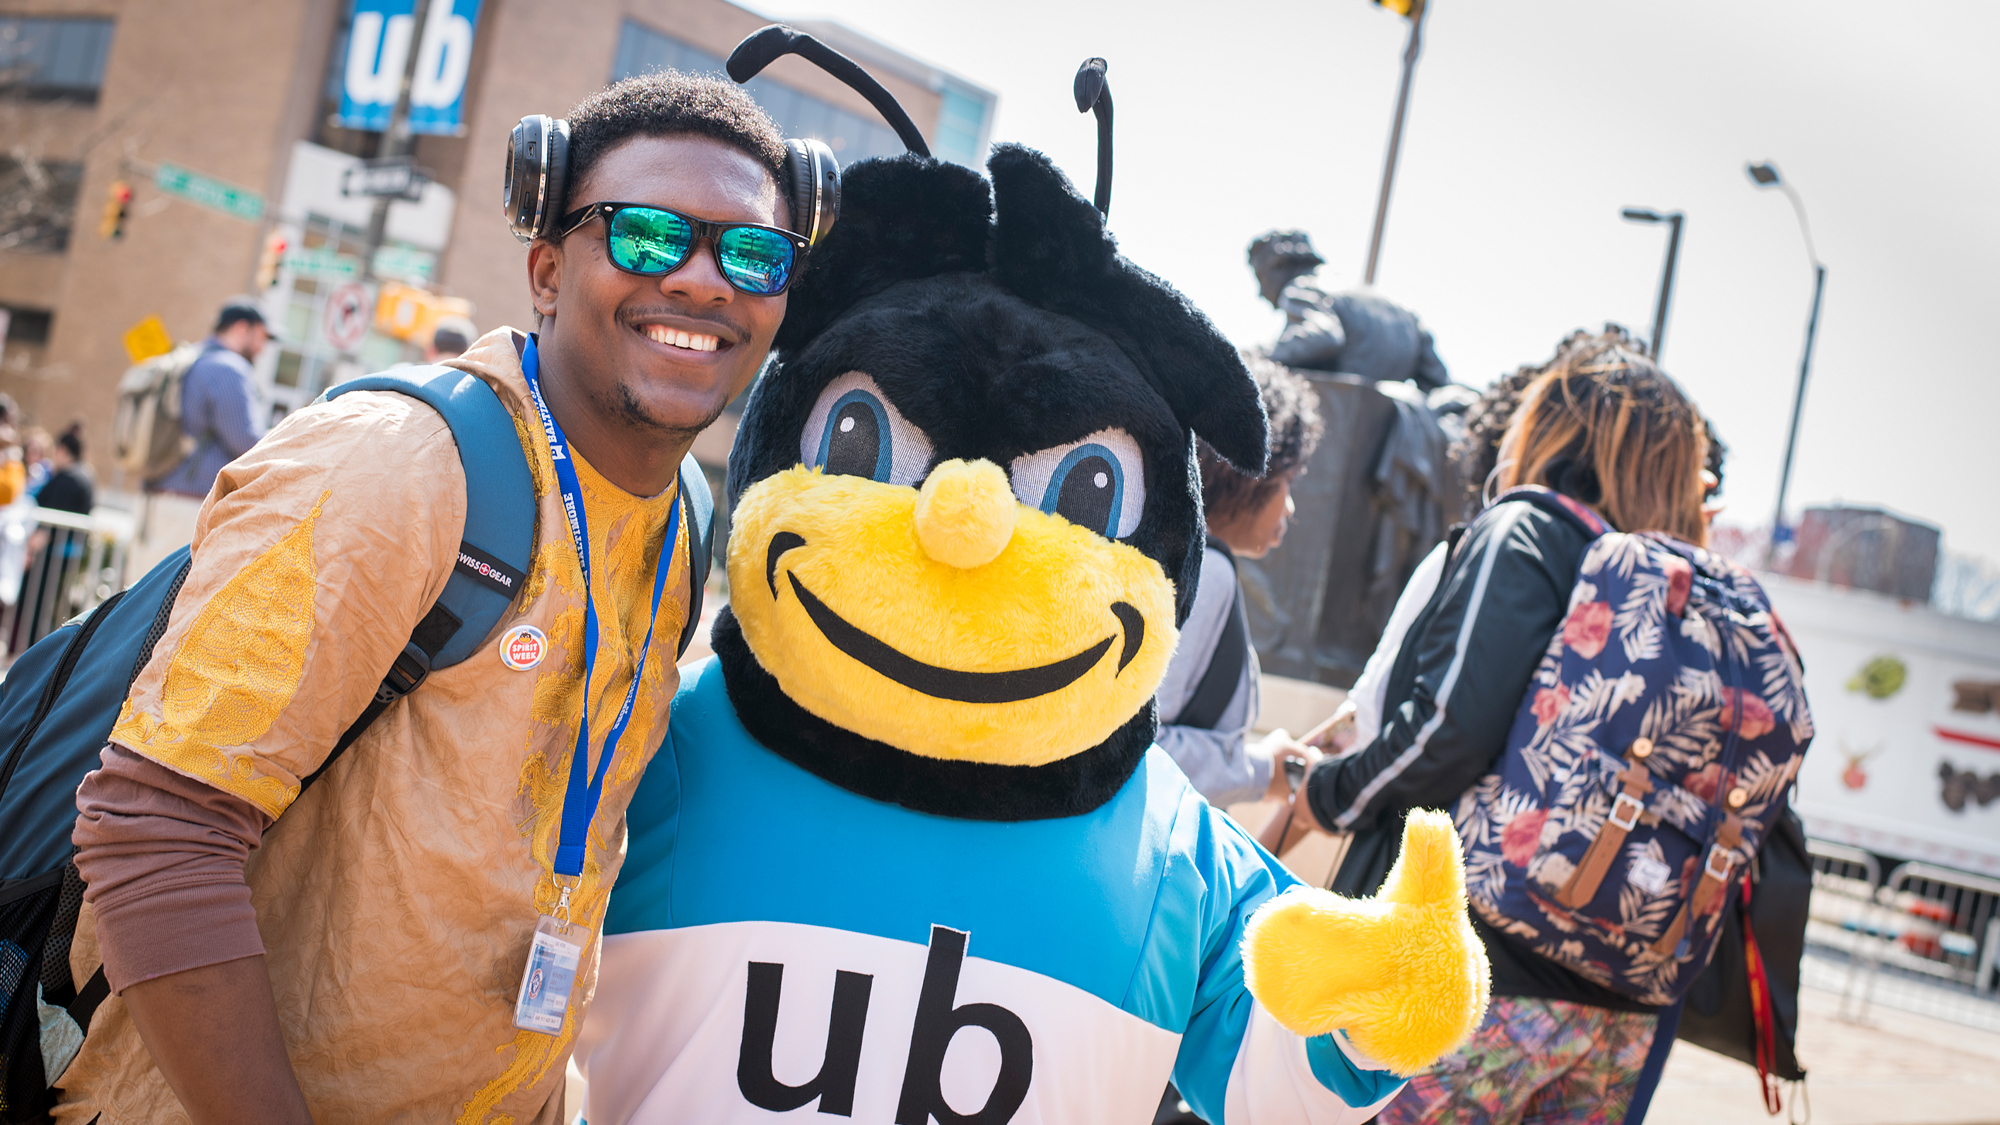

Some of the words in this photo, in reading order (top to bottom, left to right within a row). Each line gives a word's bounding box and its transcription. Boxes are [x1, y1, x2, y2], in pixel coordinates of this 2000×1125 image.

[344, 0, 473, 109] ub
[488, 568, 512, 588] GEAR
[512, 643, 537, 652] SPIRIT
[512, 652, 537, 661] WEEK
[737, 923, 1033, 1125] ub
